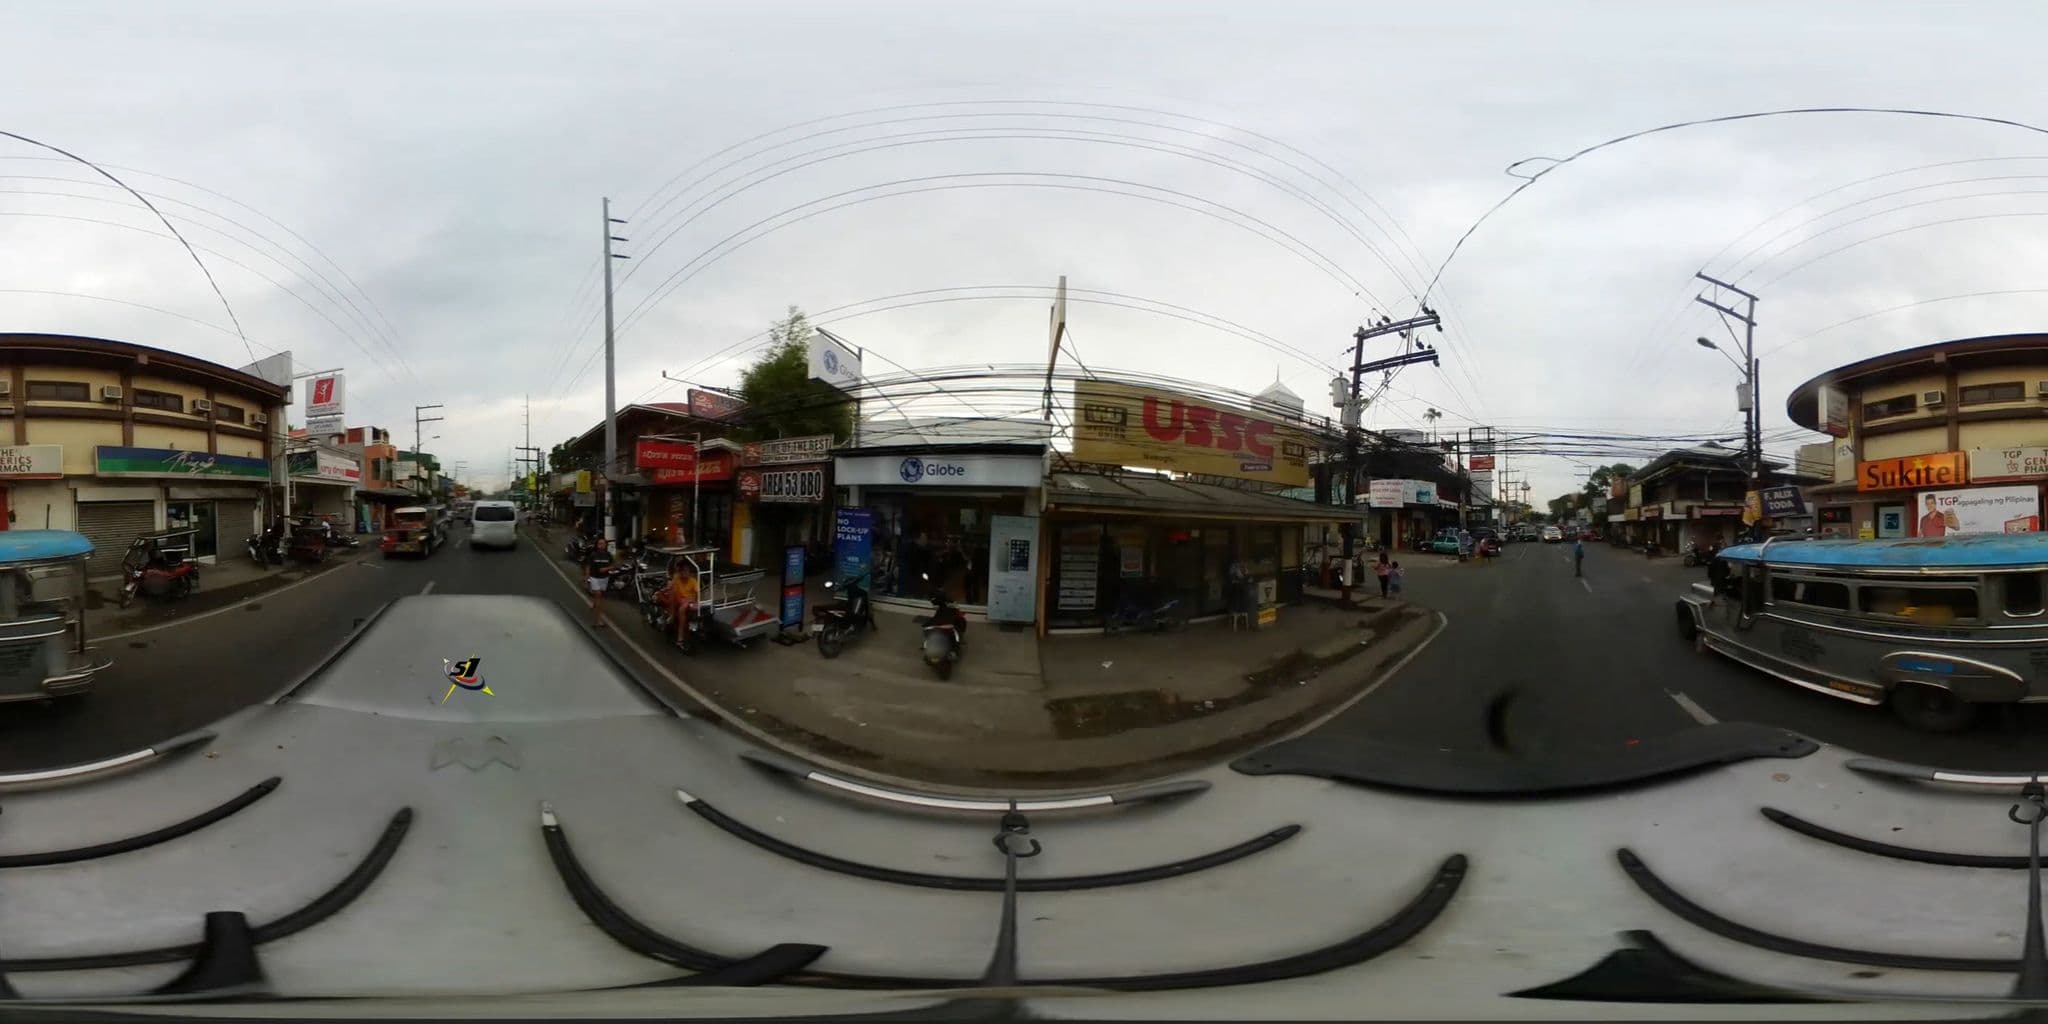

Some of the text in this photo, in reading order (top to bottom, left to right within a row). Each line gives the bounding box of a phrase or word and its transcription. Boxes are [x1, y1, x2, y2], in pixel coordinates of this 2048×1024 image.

[1143, 396, 1274, 459] USSC
[2002, 450, 2022, 459] TGP
[2024, 457, 2047, 466] GEN
[926, 464, 965, 476] Globe
[1866, 454, 1961, 488] Sukitel
[761, 471, 822, 499] AREA 53 BBQ
[1769, 500, 1795, 510] TODA
[837, 518, 849, 526] NO
[837, 526, 869, 535] LOCK-UP
[837, 533, 862, 542] PLANS
